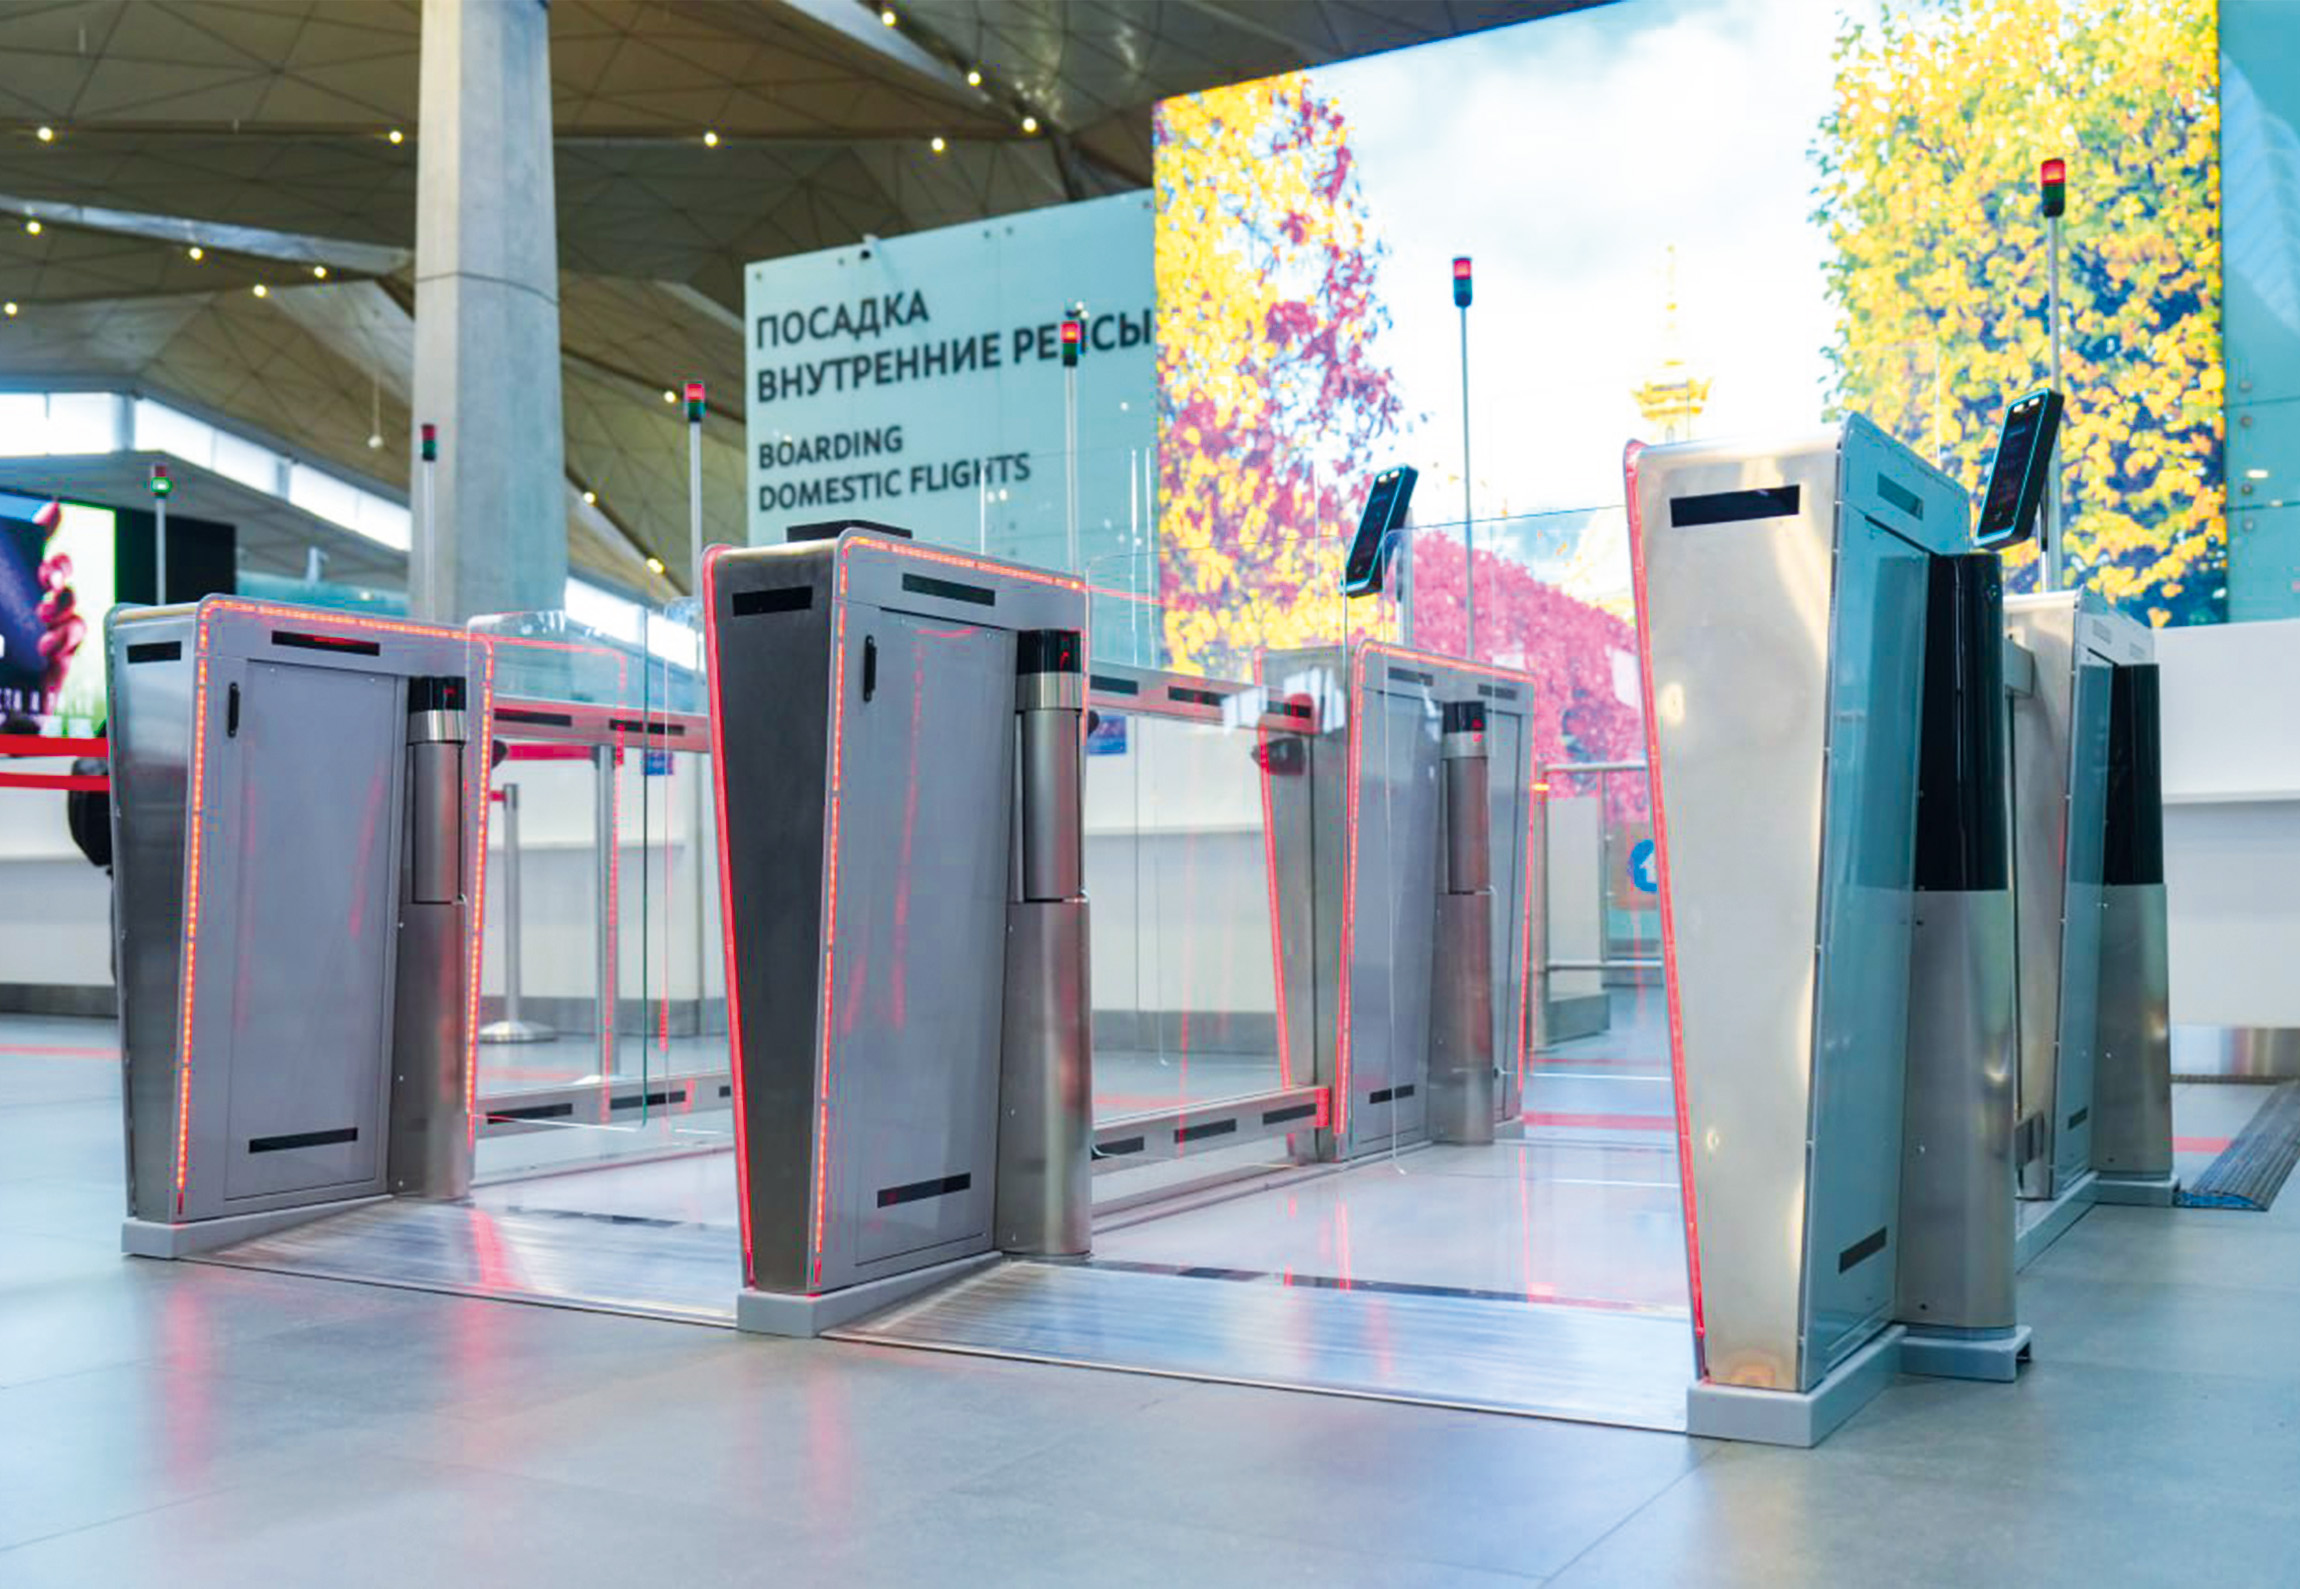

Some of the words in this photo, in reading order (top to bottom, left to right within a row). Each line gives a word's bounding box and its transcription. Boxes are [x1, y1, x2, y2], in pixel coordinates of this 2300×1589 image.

[756, 290, 930, 349] ПОСАДКА
[757, 333, 1001, 403] ВНУТРЕННИЕ
[758, 426, 903, 469] BOARDING
[759, 468, 902, 512] DOMESTIC
[910, 453, 1031, 493] FLIGHTS
